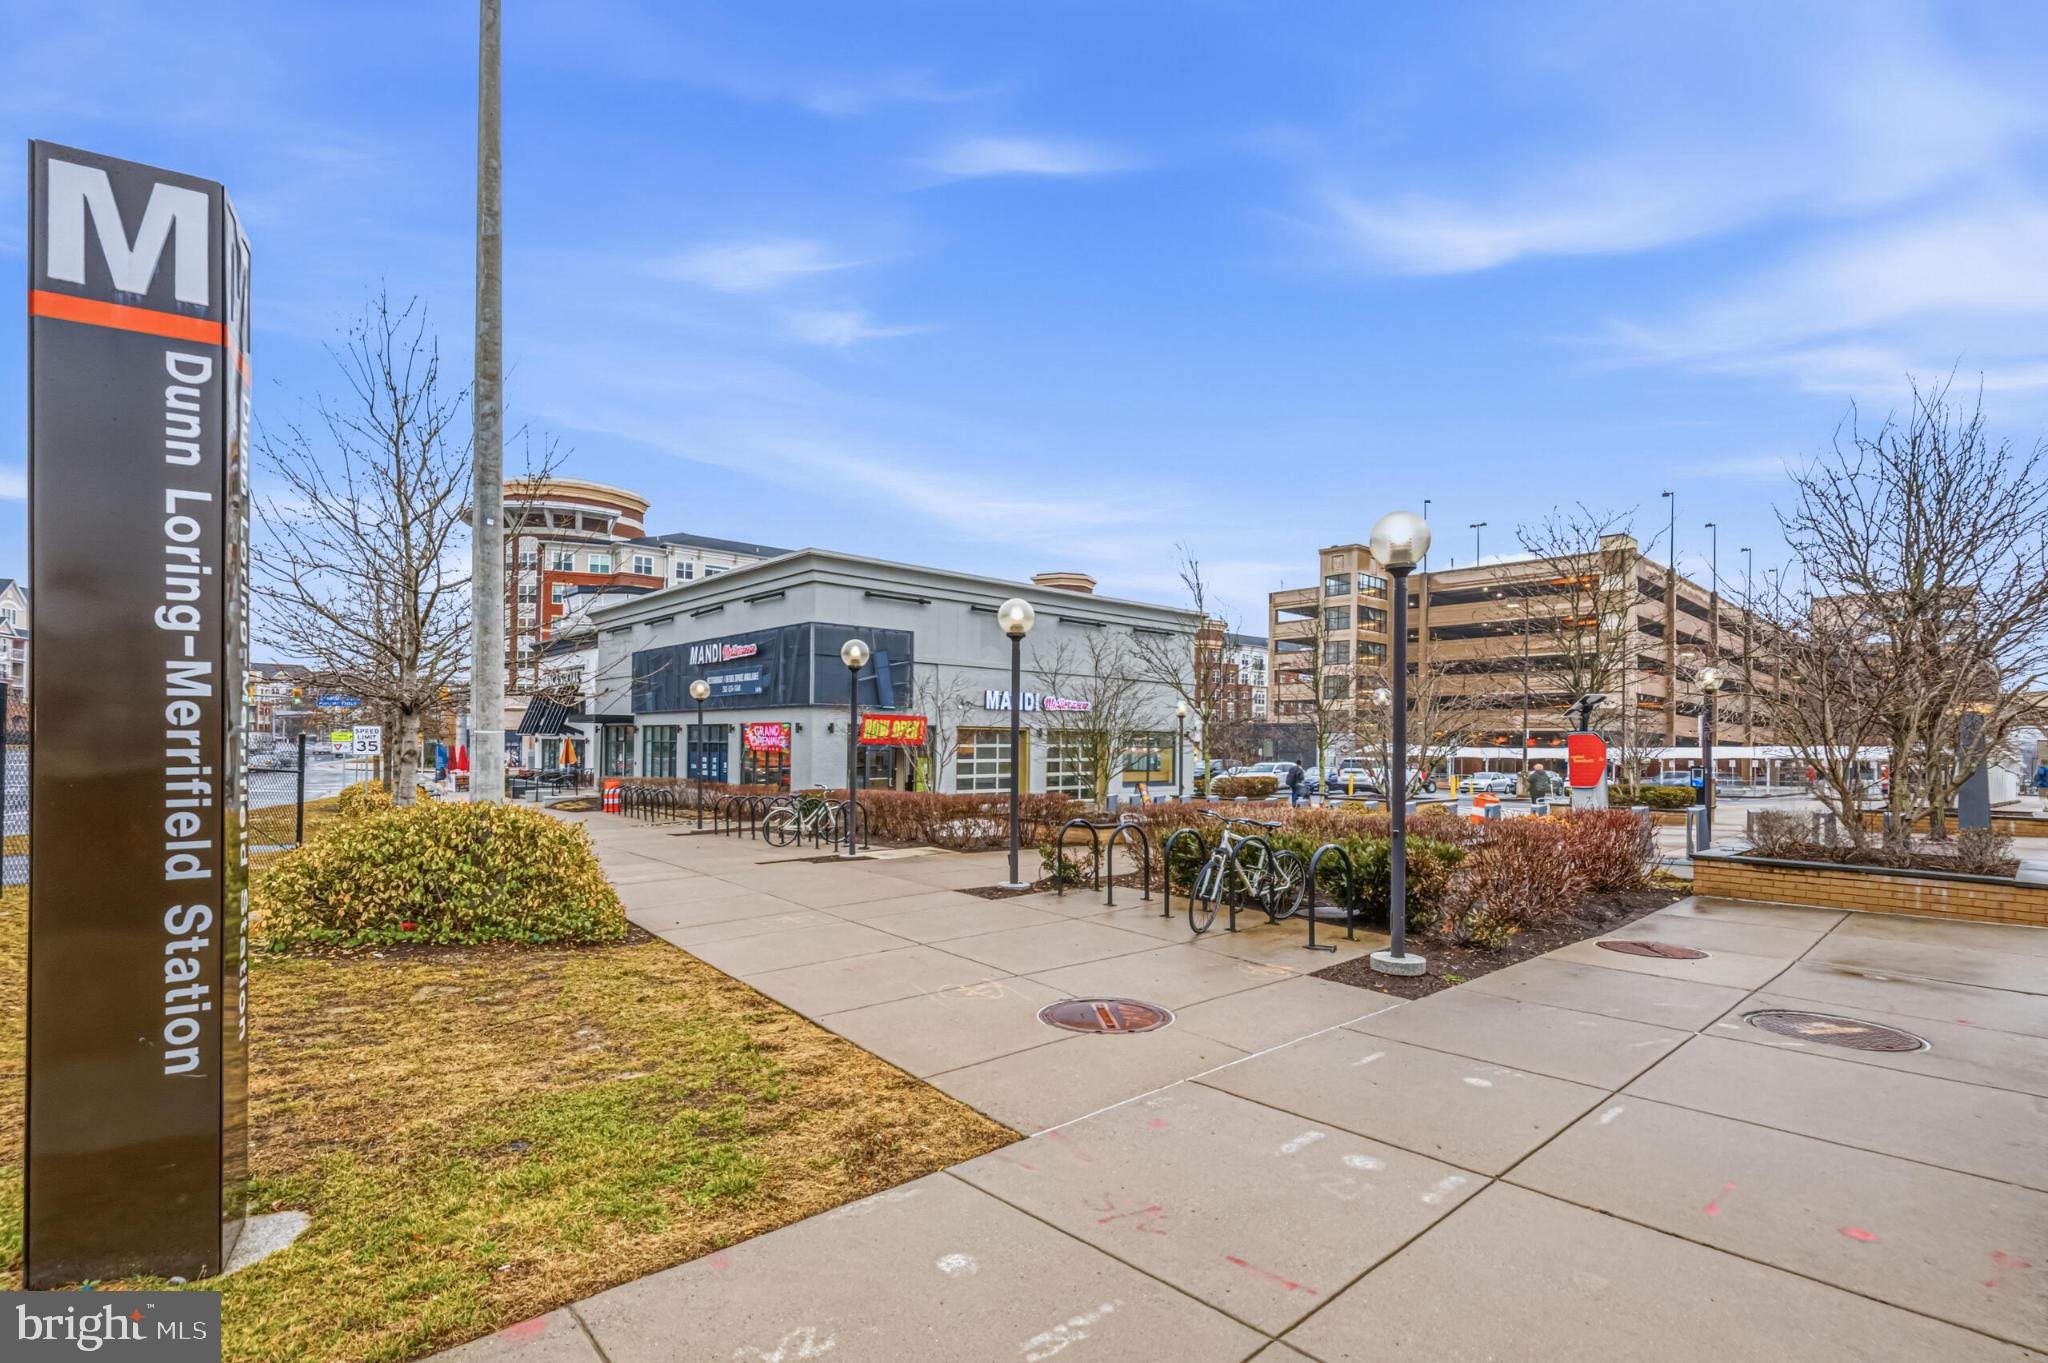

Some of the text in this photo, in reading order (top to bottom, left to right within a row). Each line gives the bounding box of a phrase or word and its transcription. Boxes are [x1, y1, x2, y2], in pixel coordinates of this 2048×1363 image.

[47, 158, 209, 307] M
[689, 642, 722, 665] MANDI
[154, 351, 213, 1075] Dunn Loring-Merrifield Station
[754, 725, 780, 736] GRAND
[863, 719, 890, 739] NOW
[356, 741, 378, 752] 35
[750, 736, 785, 746] OPENING
